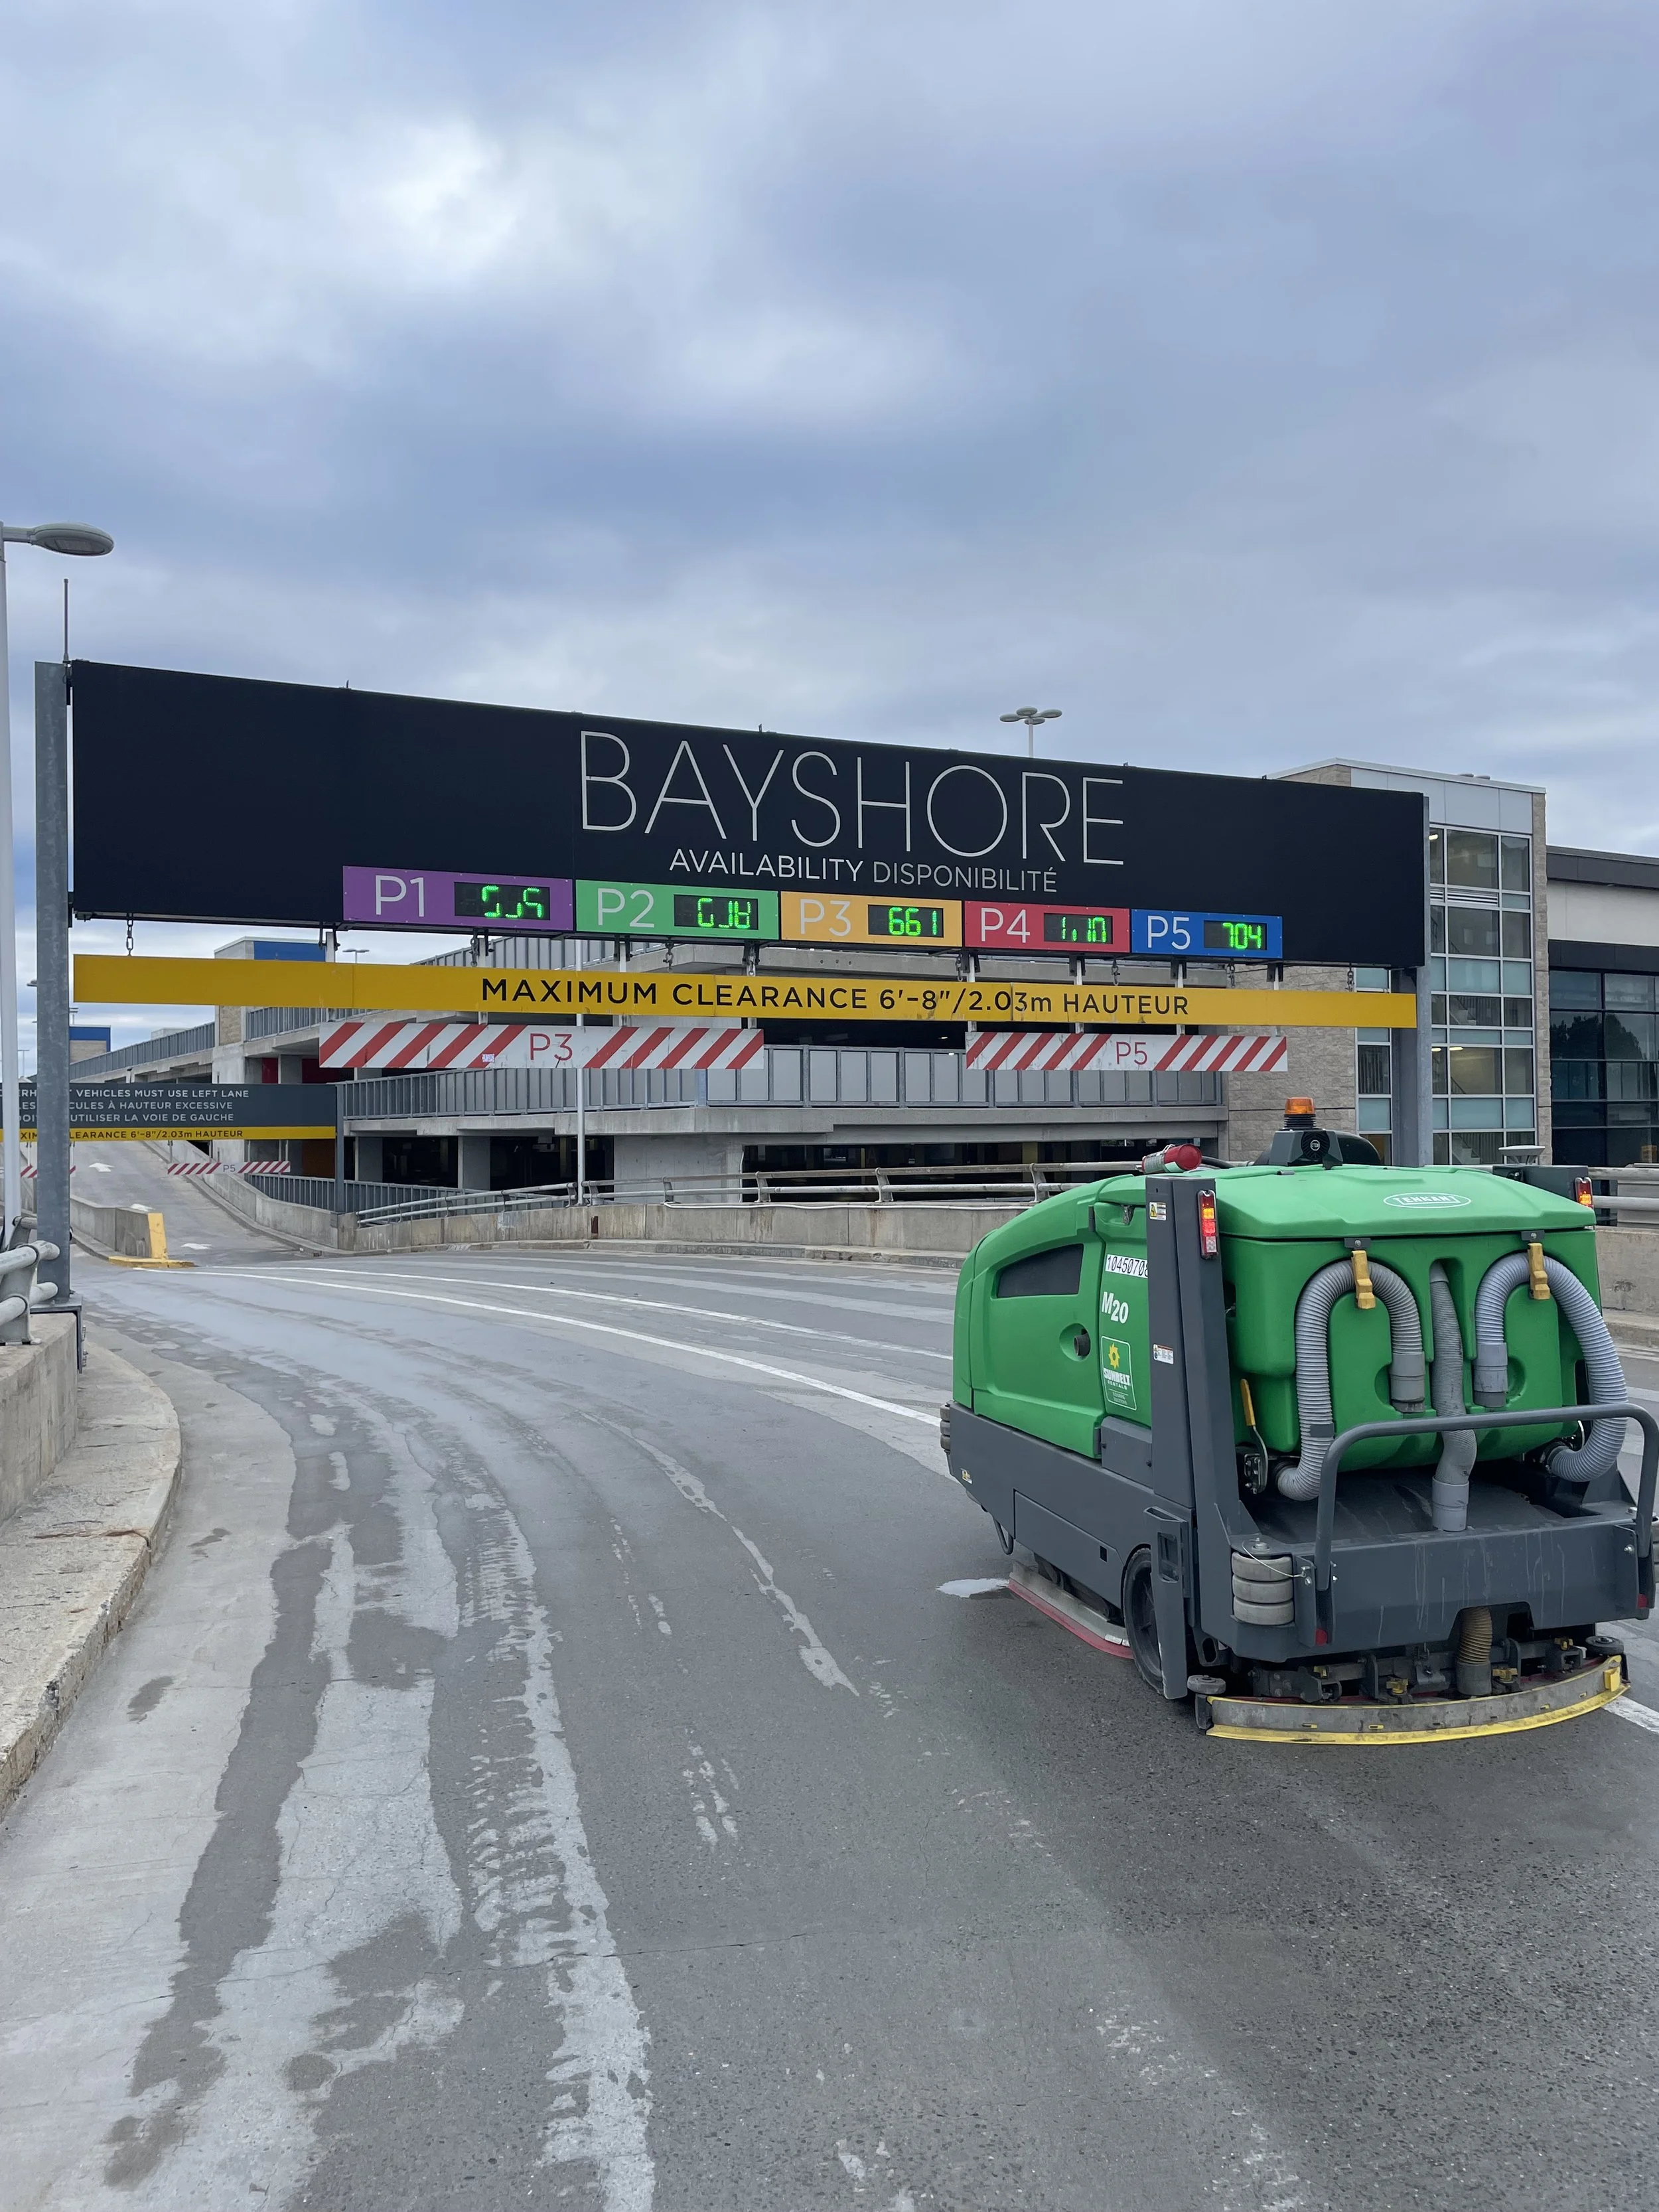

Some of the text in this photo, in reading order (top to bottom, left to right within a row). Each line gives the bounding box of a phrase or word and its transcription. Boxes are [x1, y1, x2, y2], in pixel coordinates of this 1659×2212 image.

[581, 730, 1124, 865] BAYSHORE
[670, 849, 1057, 893] AVAILABILITY DISPONIBILITÉ
[375, 875, 426, 918] P1
[597, 889, 656, 929] P2
[800, 899, 852, 937] P3
[888, 907, 938, 937] 661
[981, 908, 1031, 944] P4
[1147, 916, 1191, 951] P5
[1222, 922, 1262, 950] 704
[482, 978, 658, 1005] MAXIMUM
[672, 984, 868, 1010] CLEARANCE
[1064, 993, 1189, 1015] HAUTEUR
[530, 1033, 573, 1061] P3
[1116, 1041, 1148, 1066] P5
[76, 1089, 131, 1098] VEHICLES
[135, 1089, 164, 1098] MUST
[108, 1100, 115, 1110] À
[175, 1101, 233, 1110] EXCESSIVE
[70, 1114, 121, 1122] UTILISER
[223, 1164, 236, 1173] P5
[1101, 1291, 1129, 1324] M20
